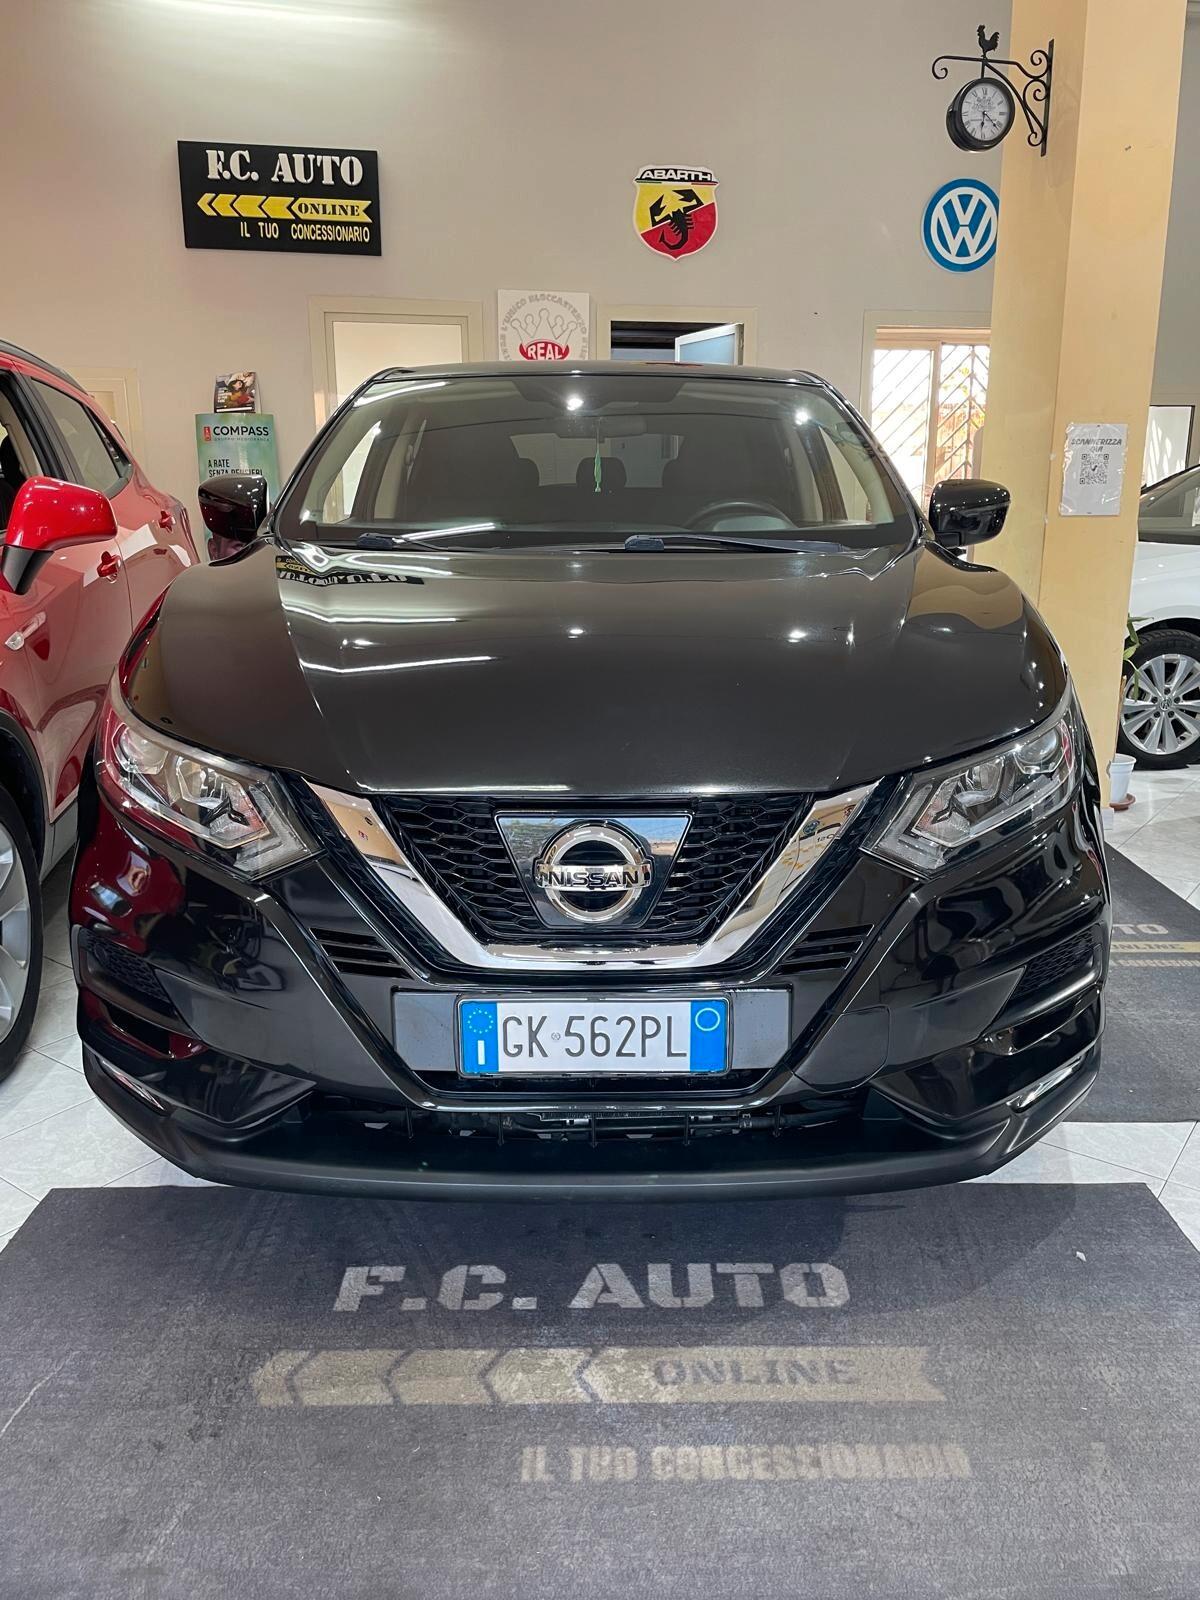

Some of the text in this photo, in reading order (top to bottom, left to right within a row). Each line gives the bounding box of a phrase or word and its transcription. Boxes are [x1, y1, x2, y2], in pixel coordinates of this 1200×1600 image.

[206, 149, 363, 187] F.C. AUTO
[641, 169, 711, 181] ABARTH
[297, 202, 360, 217] ONLINE
[240, 221, 370, 243] IL TUO CONCESSIONARIO
[527, 342, 563, 360] REAL
[213, 426, 269, 437] COMPASS
[208, 459, 230, 468] A RATE
[548, 871, 638, 886] NISSAN
[502, 1015, 688, 1058] GK 562PL
[333, 1263, 851, 1312] F.C. AUTO
[653, 1359, 858, 1386] ONLINE
[520, 1445, 553, 1483] IL
